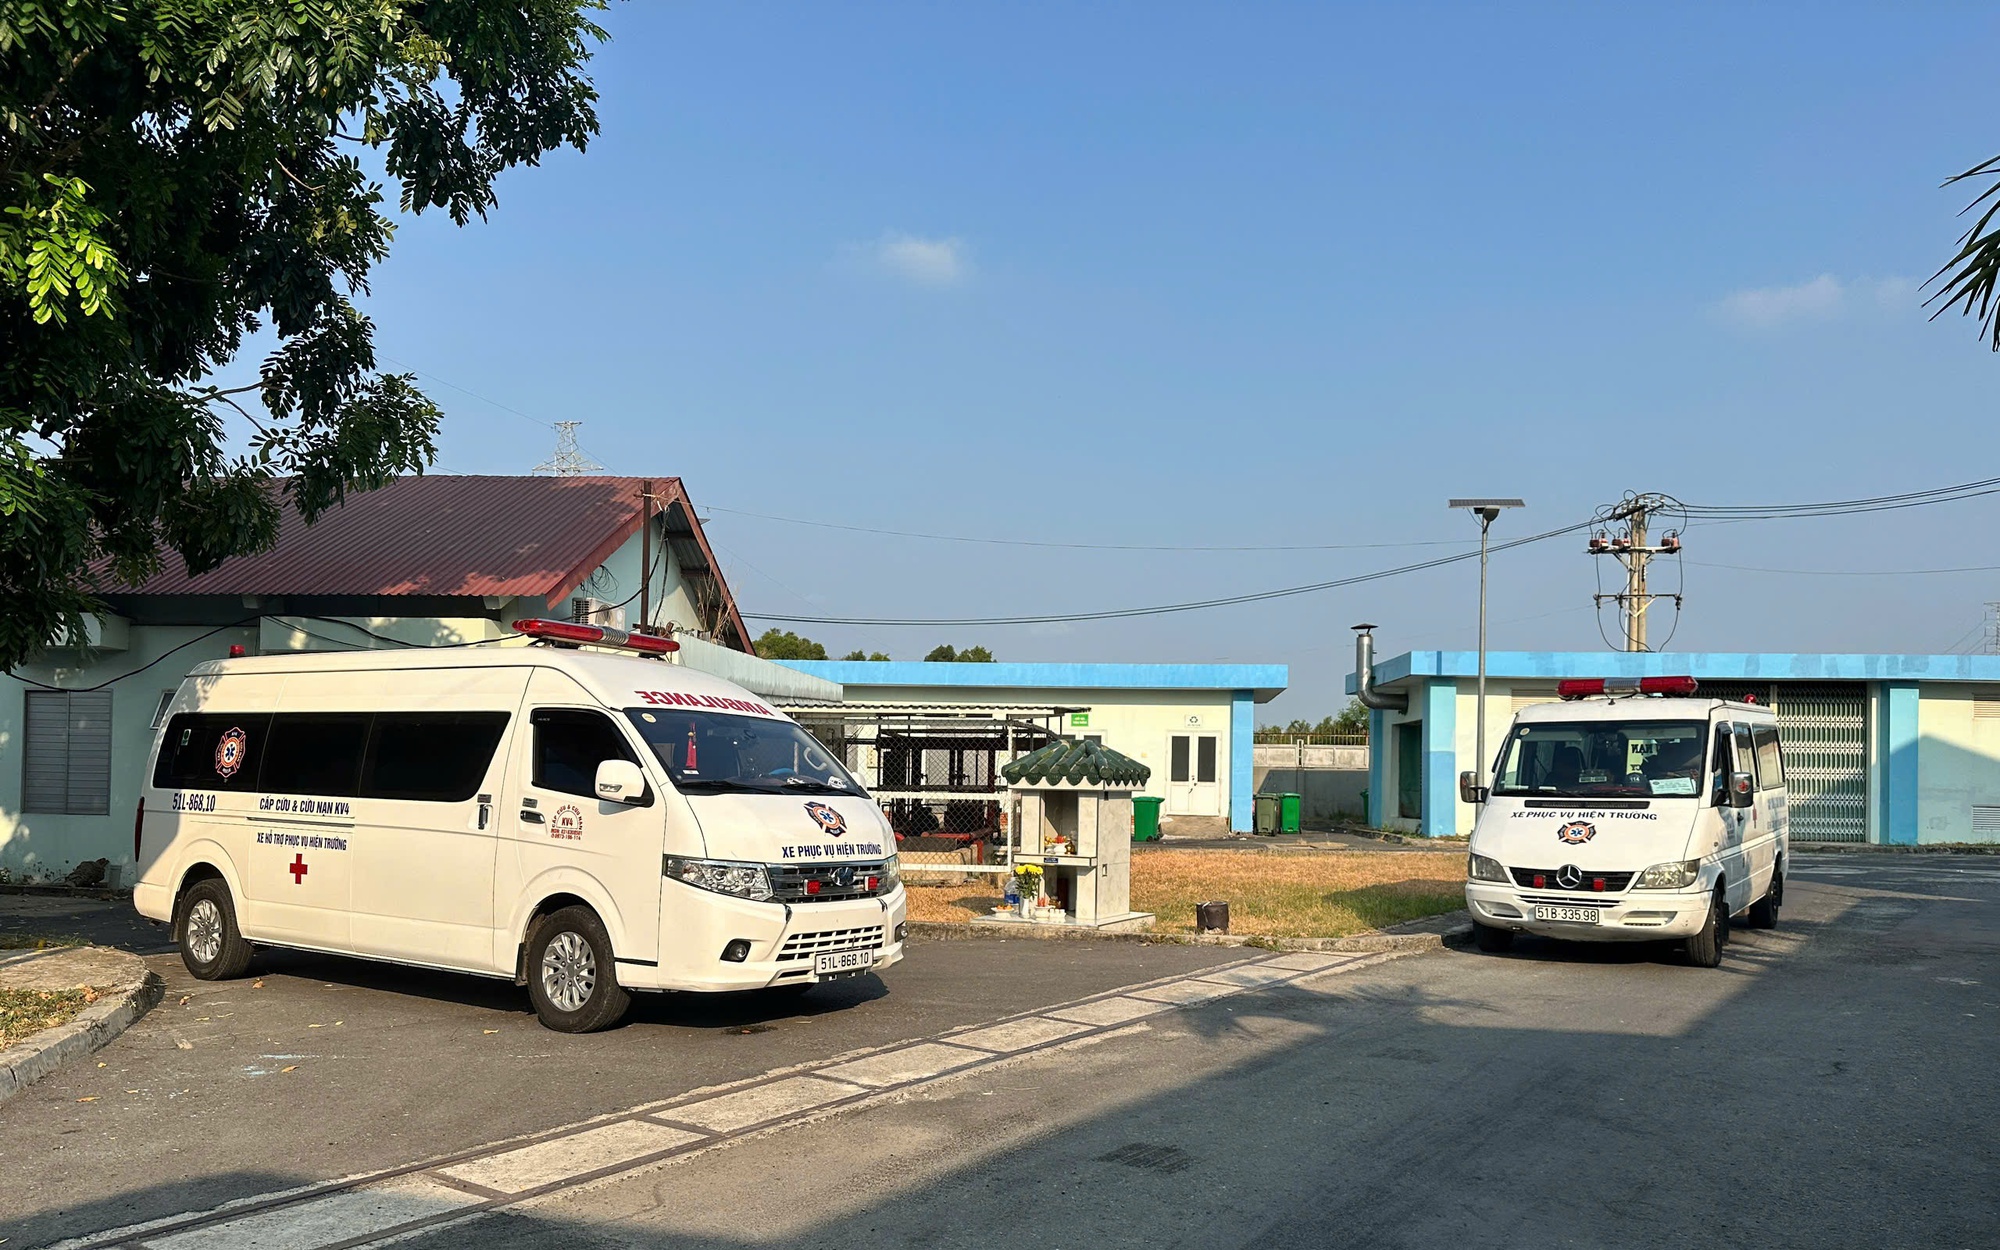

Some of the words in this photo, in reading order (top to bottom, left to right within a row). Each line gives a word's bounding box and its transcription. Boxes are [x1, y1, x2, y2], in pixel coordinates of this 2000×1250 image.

[260, 795, 274, 811] CẤP
[275, 797, 291, 811] CỨU
[292, 800, 298, 812] &
[300, 798, 315, 813] CỨU
[316, 801, 333, 816] NẠN
[334, 802, 350, 815] KV4
[561, 817, 573, 827] KV4
[1526, 811, 1557, 819] PHỤC
[1559, 811, 1575, 819] VỤ
[1577, 810, 1605, 819] HIỆN
[1610, 810, 1658, 820] TRƯỜNG
[257, 832, 265, 843] XE
[284, 834, 300, 848] PHỤC
[782, 846, 795, 858] XE
[798, 845, 822, 859] PHỤC
[823, 844, 835, 858] VỤ
[837, 841, 855, 857] HIỆN
[856, 841, 882, 855] TRƯỜNG
[1537, 907, 1597, 921] 51B-335.98
[821, 951, 869, 970] 51L-868.10
